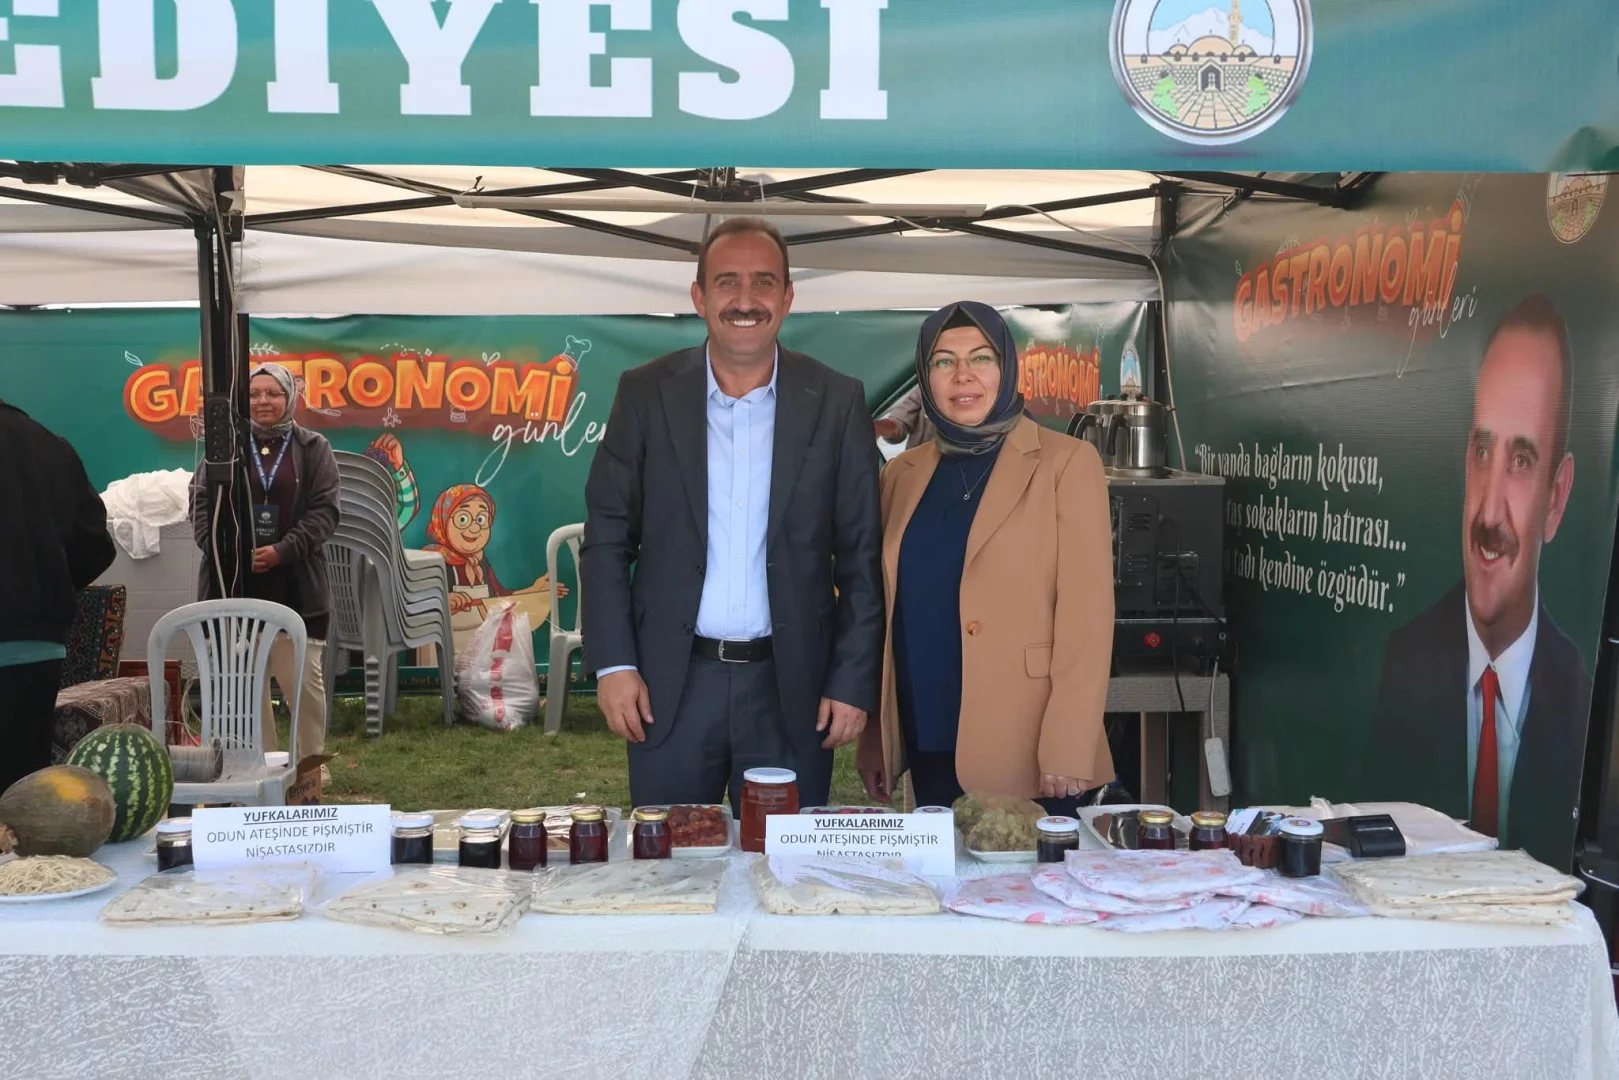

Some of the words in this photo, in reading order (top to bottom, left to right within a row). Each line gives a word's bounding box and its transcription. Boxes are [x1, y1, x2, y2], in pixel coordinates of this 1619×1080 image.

[1397, 261, 1478, 379] günleri
[1254, 442, 1313, 490] bağların
[1317, 443, 1383, 495] kokusu,
[1246, 494, 1317, 541] sokakların
[1322, 500, 1407, 552] hatırası...
[1259, 546, 1314, 594] kendine
[243, 807, 339, 823] YUFKALARIMIZ
[814, 818, 904, 829] YUFKALARIMIZ
[207, 830, 246, 844] ODUN
[249, 825, 309, 842] ATEŞİNDE
[313, 822, 374, 838] PİŞMİŞTİR
[780, 834, 817, 844] ODUN
[820, 833, 876, 847] ATEŞİNDE
[879, 832, 939, 847] PİŞMİŞTİR
[245, 842, 336, 860] NİŞASTASIZDIR
